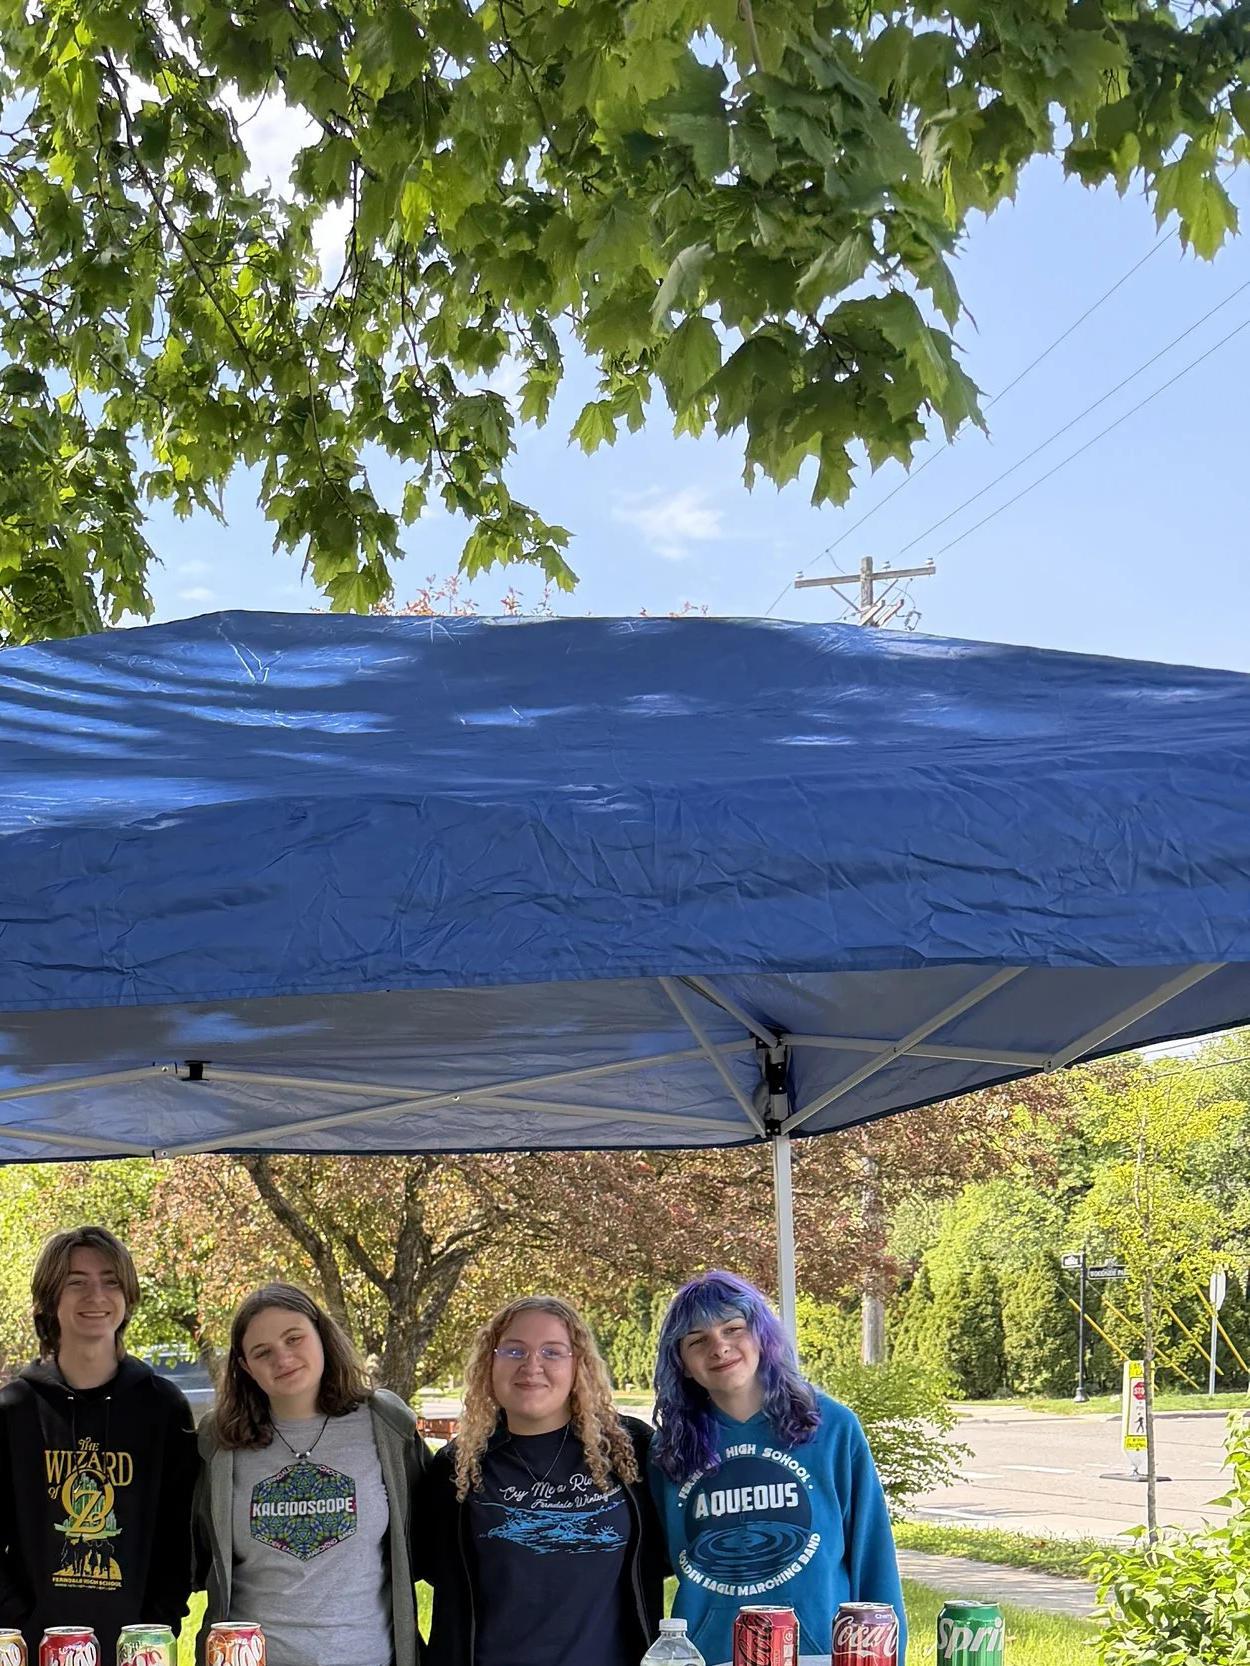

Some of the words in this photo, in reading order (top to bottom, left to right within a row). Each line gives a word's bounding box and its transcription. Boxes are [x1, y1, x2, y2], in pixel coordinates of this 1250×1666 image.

[78, 1437, 99, 1451] THE
[45, 1450, 134, 1486] WIZARD
[726, 1444, 756, 1458] HIGH
[762, 1447, 809, 1483] SCHOOL
[48, 1485, 61, 1499] of
[531, 1481, 556, 1498] Me
[694, 1483, 799, 1519] AQUEOUS
[252, 1496, 354, 1517] KALEIDOSCOPE
[678, 1550, 703, 1584] GOLDEN
[702, 1576, 737, 1596] EAGLE
[738, 1561, 802, 1597] MARCHING
[798, 1533, 821, 1565] BAND
